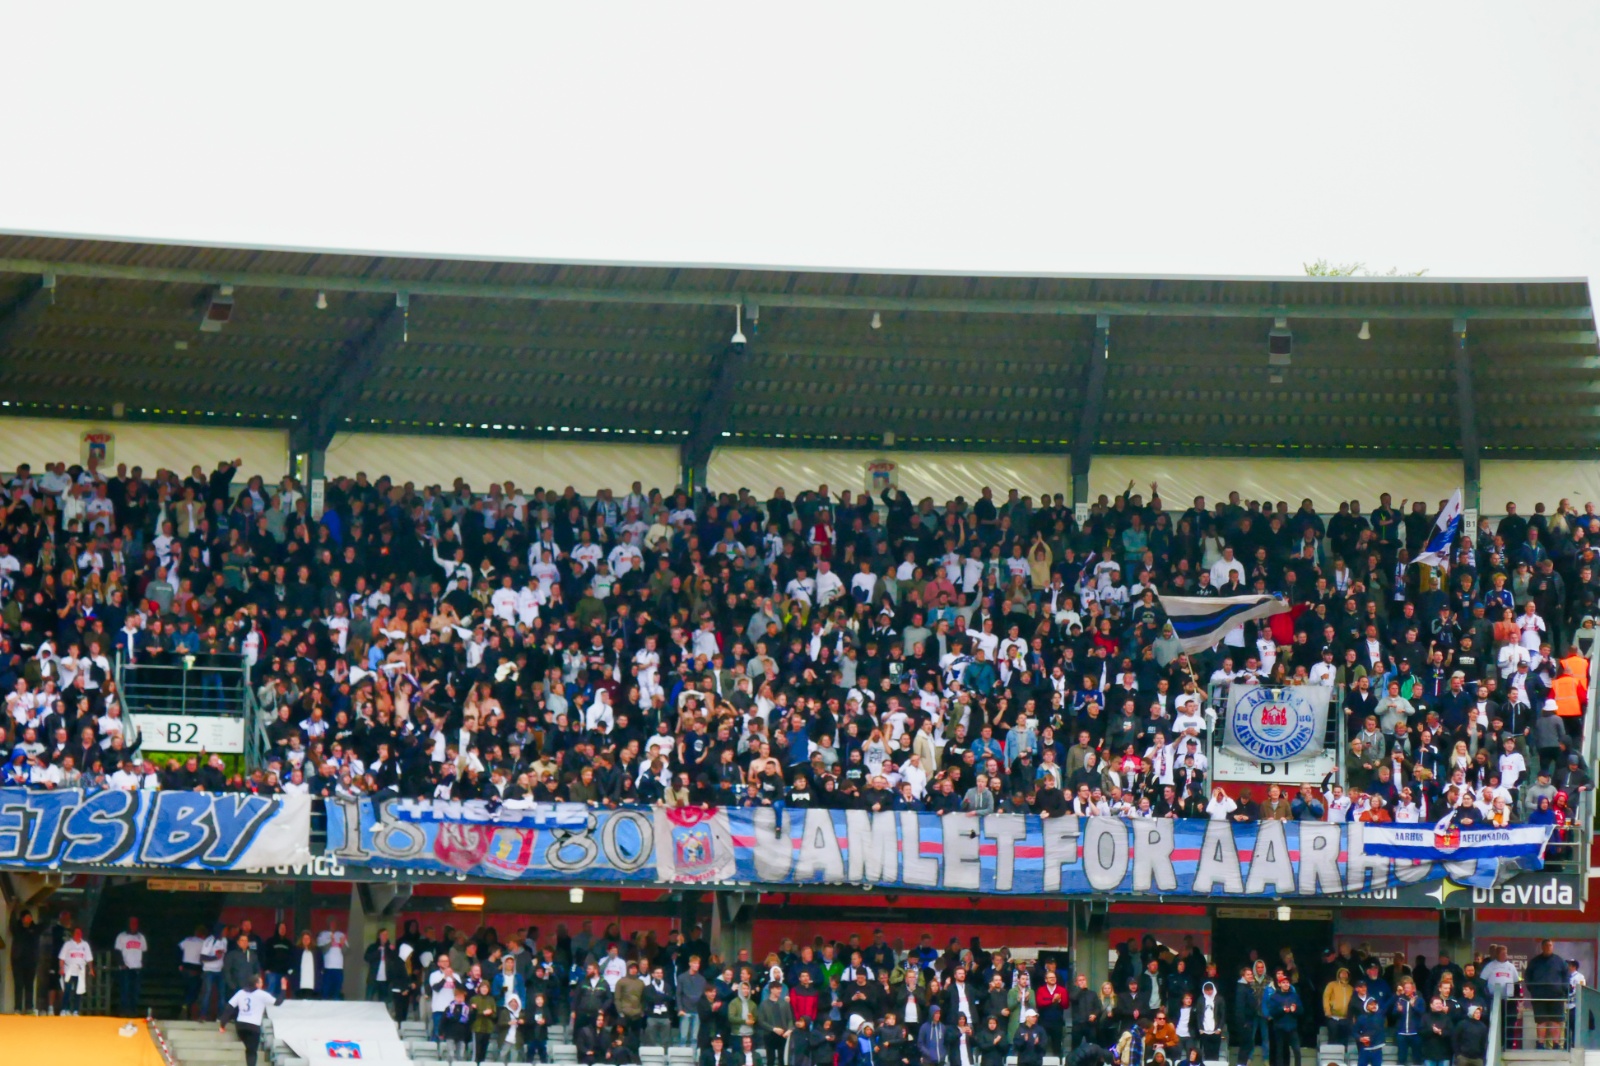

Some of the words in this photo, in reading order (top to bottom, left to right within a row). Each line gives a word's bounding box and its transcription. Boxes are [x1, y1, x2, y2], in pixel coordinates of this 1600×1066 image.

[167, 723, 198, 744] B2
[1236, 724, 1311, 757] AFICIONADOS
[141, 790, 272, 863] BY
[1395, 832, 1423, 842] AARHUS
[1462, 832, 1510, 843] AFICIONADOS
[1043, 815, 1177, 891] FOR
[1473, 878, 1573, 904] bravida
[242, 997, 252, 1013] 3
